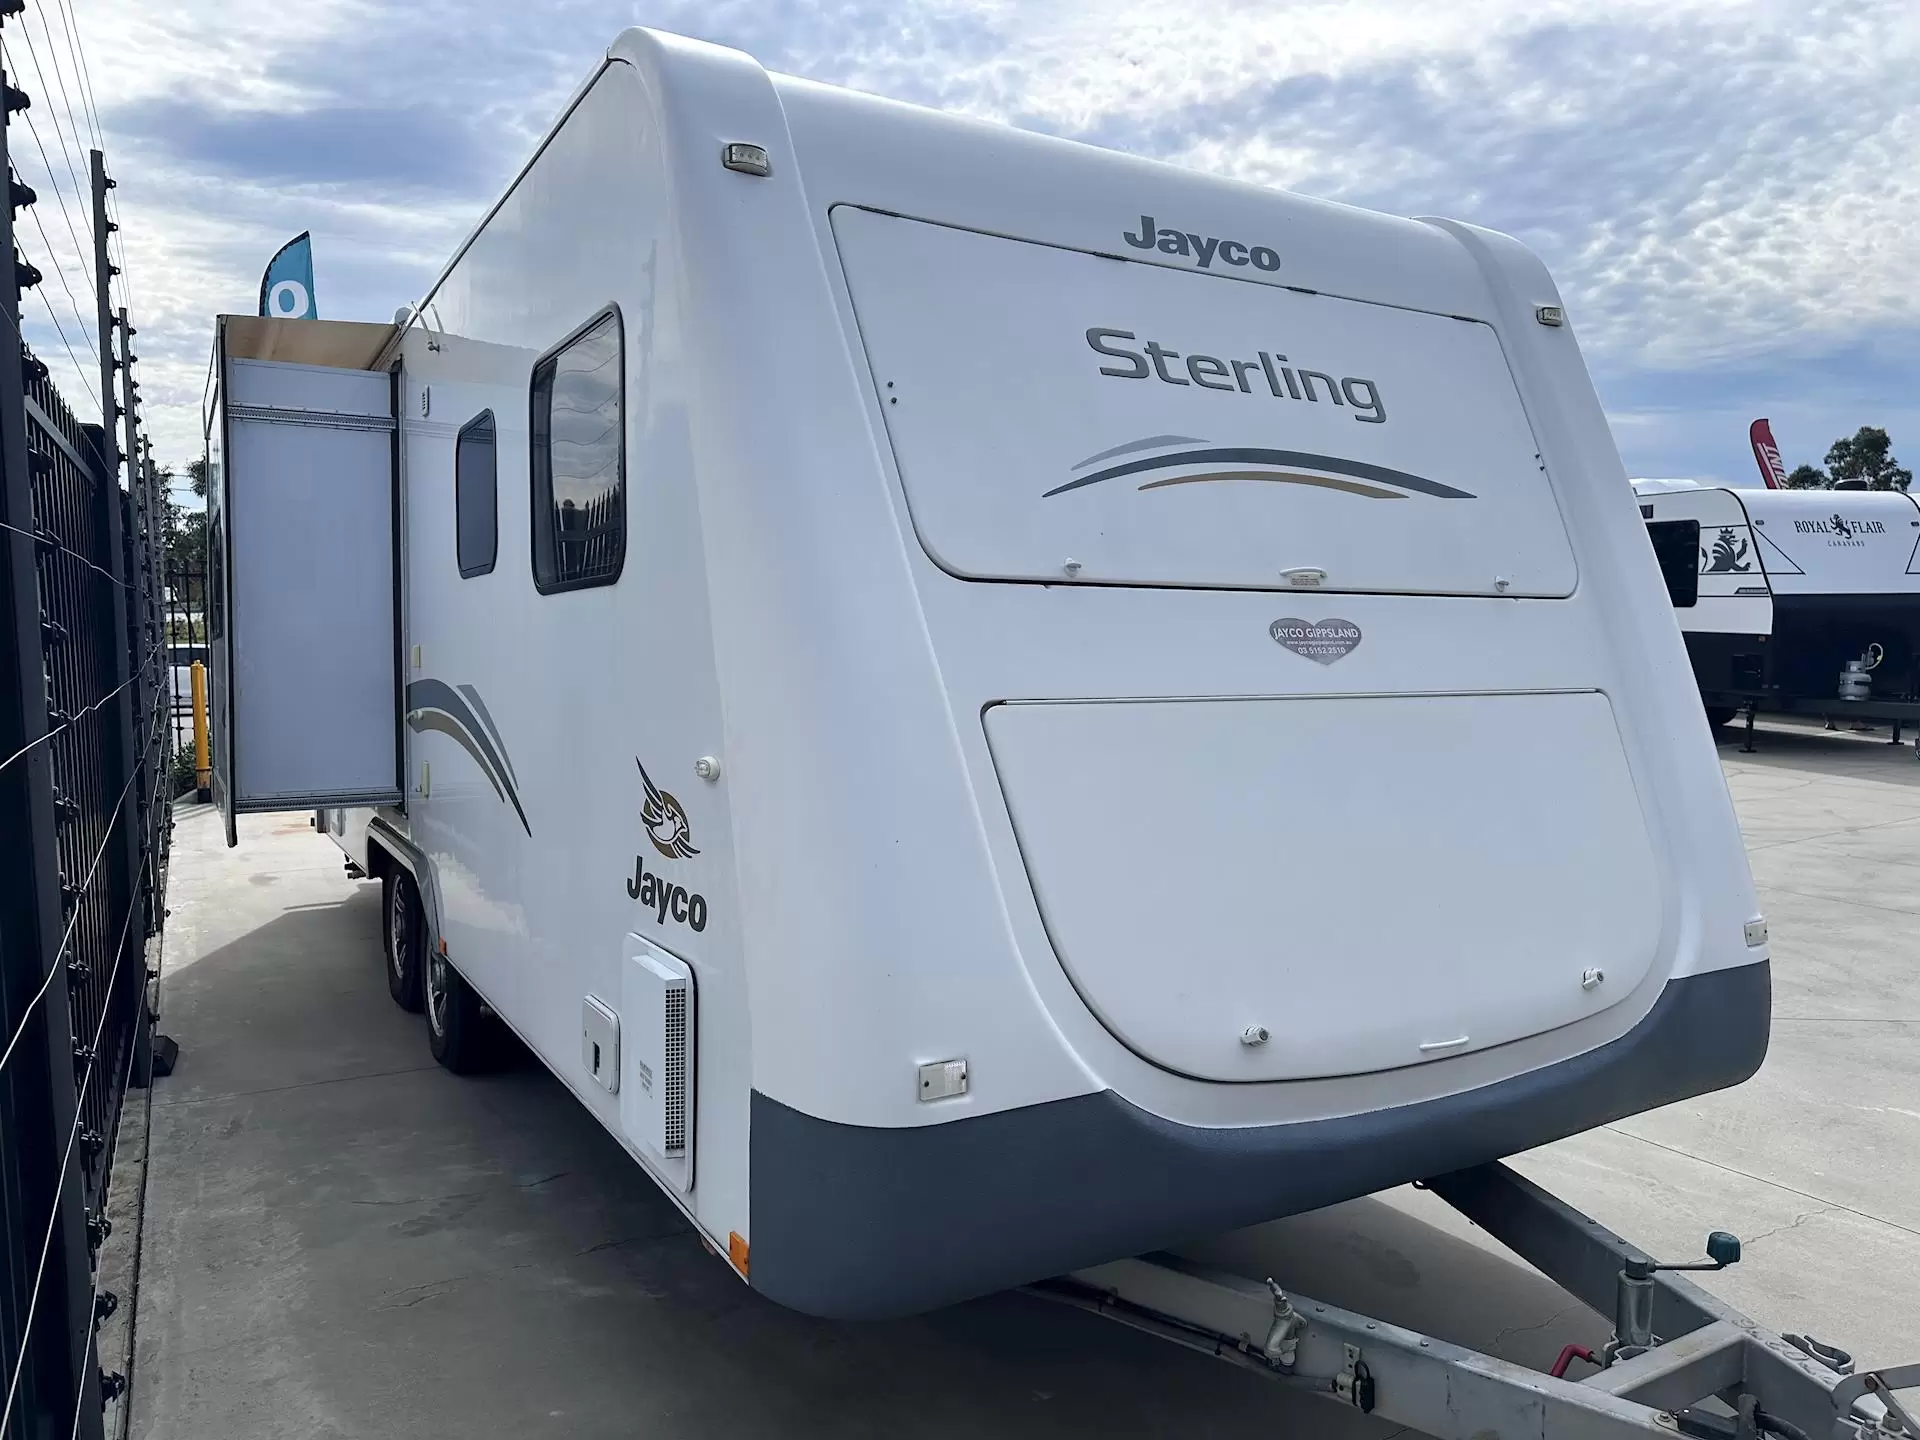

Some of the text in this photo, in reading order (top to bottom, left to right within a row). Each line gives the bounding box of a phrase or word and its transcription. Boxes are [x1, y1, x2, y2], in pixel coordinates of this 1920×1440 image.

[1123, 215, 1281, 272] Jayco
[1086, 327, 1387, 424] Sterling
[1793, 519, 1887, 534] ROYAL FLAIR
[1273, 627, 1359, 640] JAYCO GIPPSLAND
[1297, 646, 1308, 654] 03
[1308, 646, 1327, 654] 5152
[626, 854, 707, 933] Jayco
